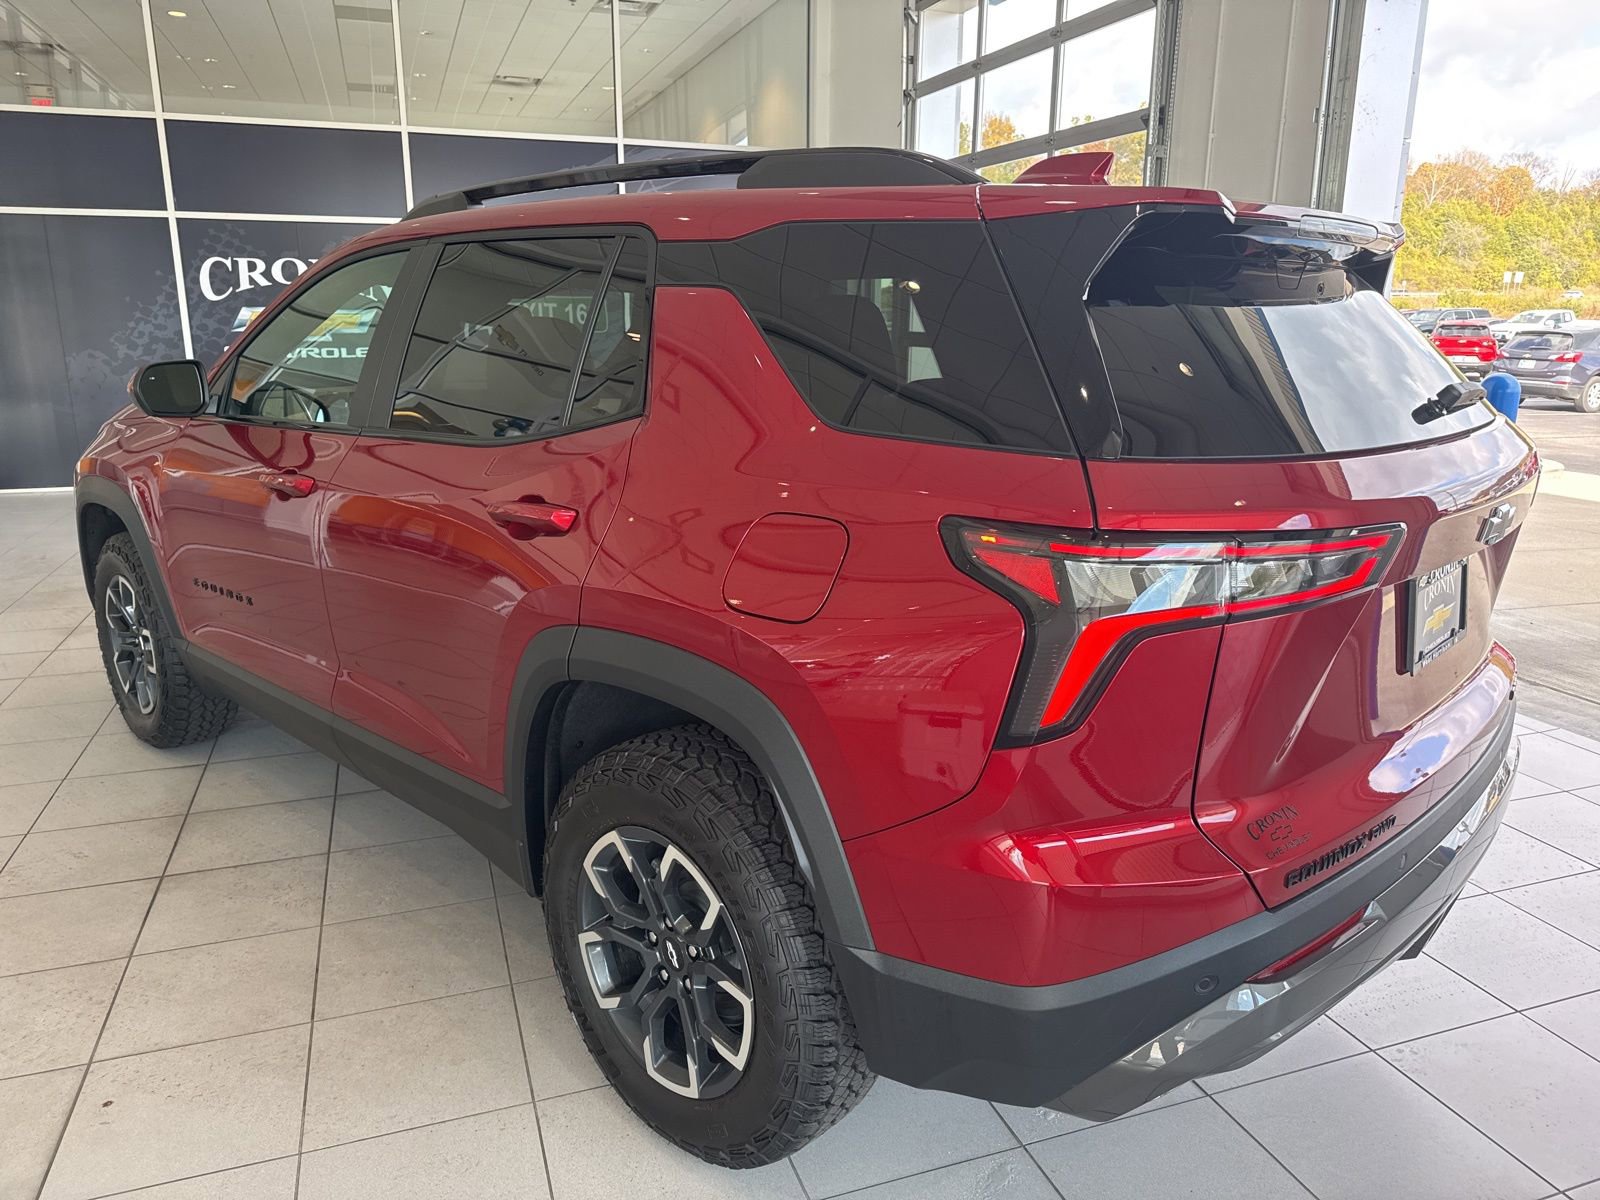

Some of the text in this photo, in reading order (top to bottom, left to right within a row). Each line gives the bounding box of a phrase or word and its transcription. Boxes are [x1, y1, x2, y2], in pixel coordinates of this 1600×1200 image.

[199, 256, 319, 301] CRO
[523, 302, 558, 318] XIT
[193, 577, 254, 606] EQUINOX
[1424, 574, 1456, 612] CRONIN
[1246, 805, 1299, 841] CRONIN
[1283, 814, 1397, 889] EQUINOX AWD
